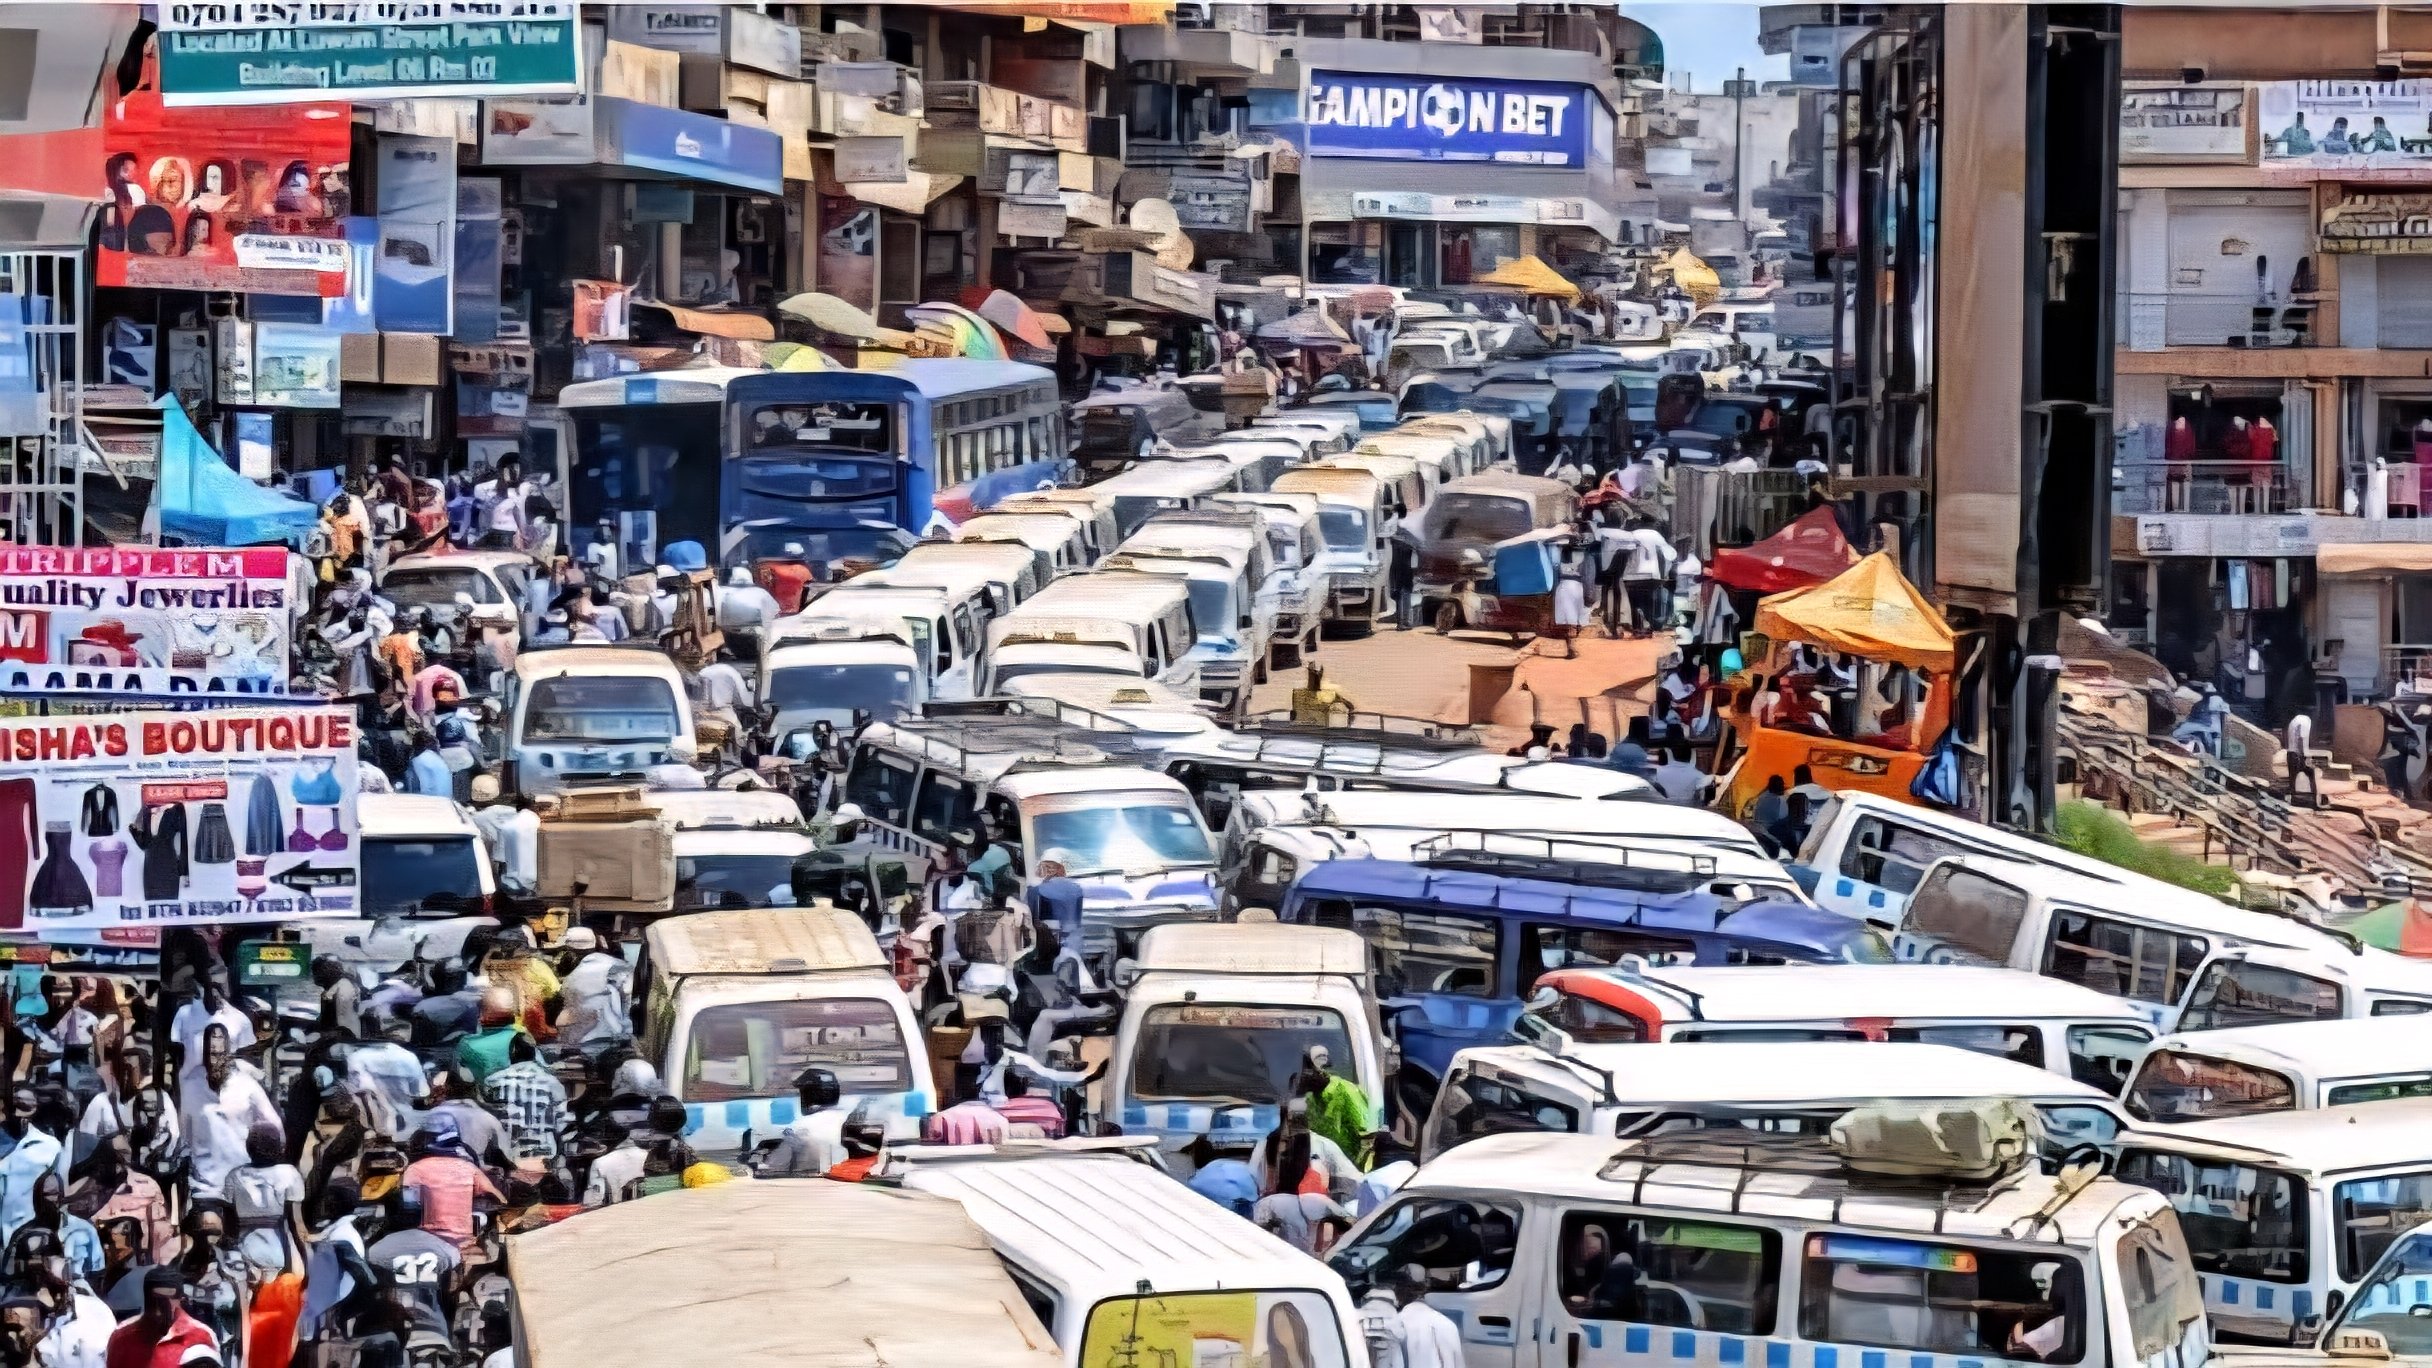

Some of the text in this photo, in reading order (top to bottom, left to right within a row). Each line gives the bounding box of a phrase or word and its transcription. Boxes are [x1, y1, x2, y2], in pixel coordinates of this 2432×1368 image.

[1502, 93, 1569, 136] BET
[143, 715, 351, 755] BOUTIQUE
[392, 1252, 438, 1284] 32
